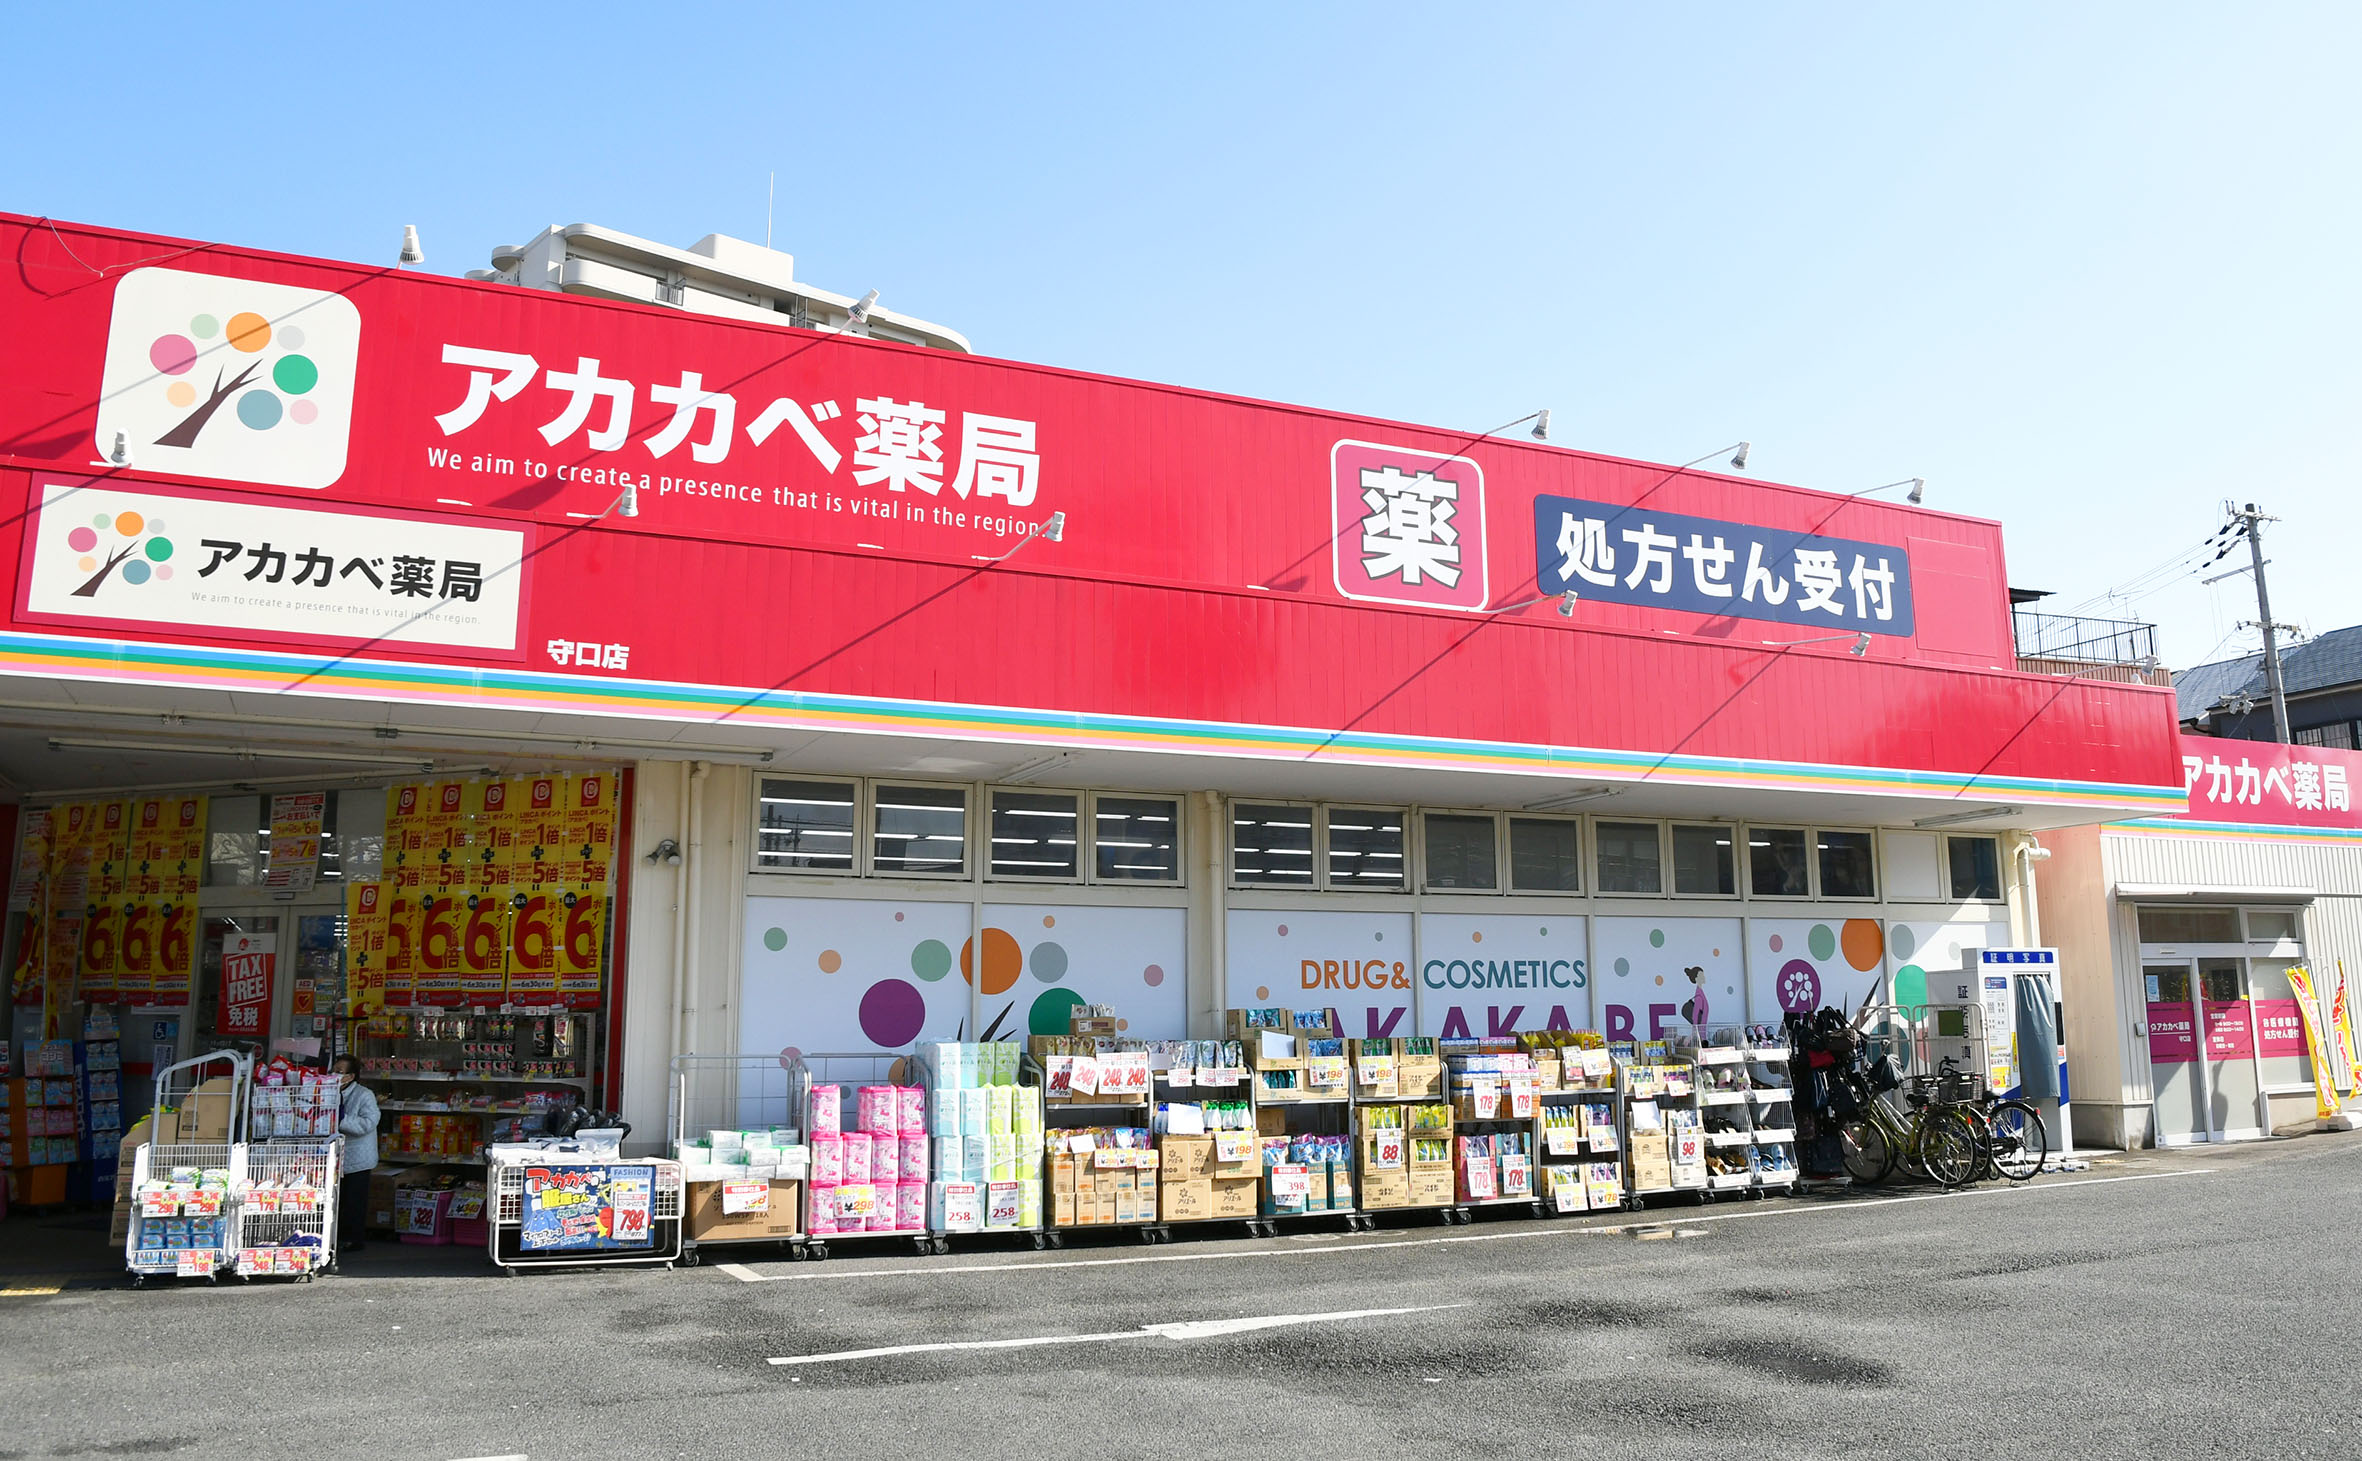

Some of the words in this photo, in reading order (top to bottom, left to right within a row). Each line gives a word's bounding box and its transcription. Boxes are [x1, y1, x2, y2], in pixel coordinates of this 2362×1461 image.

[434, 343, 1041, 507] アカカベ薬局
[427, 447, 462, 470] We
[471, 453, 514, 475] aim
[524, 457, 548, 479] to
[556, 464, 631, 487] create
[639, 473, 651, 490] a
[659, 475, 762, 503] presence
[773, 486, 817, 510] that
[826, 492, 842, 512] is
[850, 496, 898, 519] vital
[906, 503, 925, 523] in
[933, 507, 966, 528] the
[973, 513, 1047, 537] region.
[1358, 465, 1463, 588] 薬
[197, 538, 483, 602] アカカベ薬局
[1556, 511, 1895, 622] 処方せん受付
[191, 592, 207, 601] We
[210, 593, 230, 603] aim
[234, 595, 245, 605] to
[248, 597, 282, 608] create
[295, 601, 343, 613] presence
[347, 605, 369, 615] that
[372, 607, 381, 616] is
[384, 608, 408, 618] vital
[411, 611, 421, 620] in
[425, 611, 441, 622] the
[444, 614, 481, 625] region.
[546, 638, 630, 671] 守口店
[2181, 755, 2350, 812] アカカベ薬局
[532, 861, 559, 884] 5倍
[581, 860, 606, 883] 5倍
[85, 905, 114, 971] 6
[123, 905, 150, 971] 6
[161, 905, 189, 971] 6
[421, 898, 458, 969] 6
[464, 897, 502, 970] 6
[514, 896, 553, 970] 6
[565, 895, 597, 969] 6
[228, 954, 261, 982] TAX
[1300, 959, 1412, 990] DRUG&
[1423, 959, 1587, 989] COSMETICS
[228, 976, 265, 1003] FREE
[227, 1007, 259, 1027] 免税
[1050, 1071, 1071, 1091] 248
[1074, 1065, 1096, 1086] 248
[1103, 1067, 1122, 1087] 248
[1127, 1067, 1146, 1086] 248
[1319, 1069, 1343, 1080] ¥198
[1368, 1069, 1392, 1079] ¥198
[1480, 1095, 1493, 1110] 178
[1517, 1094, 1530, 1109] 178
[1227, 1145, 1252, 1156] ¥198
[1382, 1144, 1399, 1160] 88
[1557, 1140, 1577, 1150] ¥398
[1682, 1141, 1696, 1156] 98
[526, 1167, 593, 1193] アカカベ
[613, 1168, 649, 1176] FASHION
[1474, 1172, 1489, 1189] 178
[1508, 1168, 1524, 1187] 178
[1288, 1181, 1305, 1191] 398
[158, 1203, 174, 1213] 298
[199, 1202, 215, 1213] 298
[259, 1201, 275, 1211] 178
[297, 1201, 312, 1211] 178
[844, 1200, 874, 1213] ¥298
[1596, 1193, 1618, 1204] ¥178
[620, 1209, 645, 1231] 798
[948, 1211, 971, 1221] 258
[992, 1206, 1016, 1218] 258
[193, 1262, 209, 1273] 198
